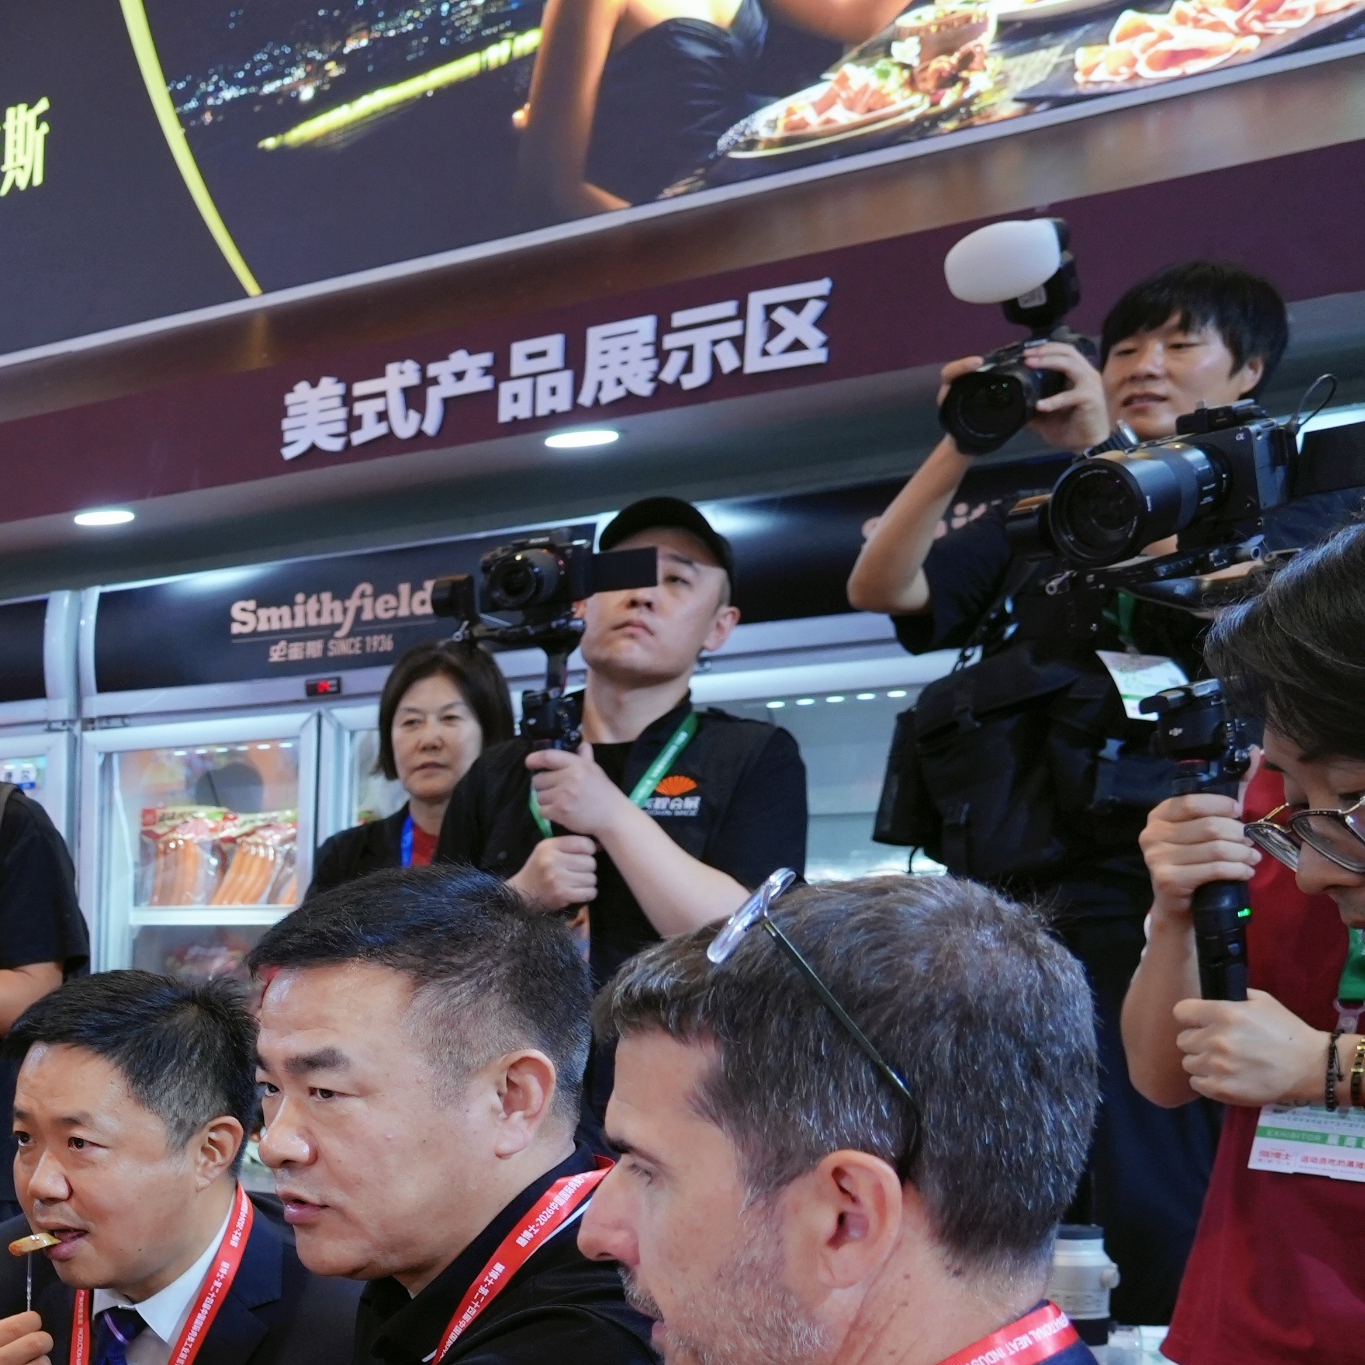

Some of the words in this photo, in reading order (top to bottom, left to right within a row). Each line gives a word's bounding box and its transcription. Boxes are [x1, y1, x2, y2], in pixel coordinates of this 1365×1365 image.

[280, 277, 834, 461] 美式产品展示区
[230, 578, 436, 639] Smithfield
[327, 636, 363, 658] SINCE
[365, 634, 395, 653] 1936
[1006, 1336, 1033, 1357] MEAT
